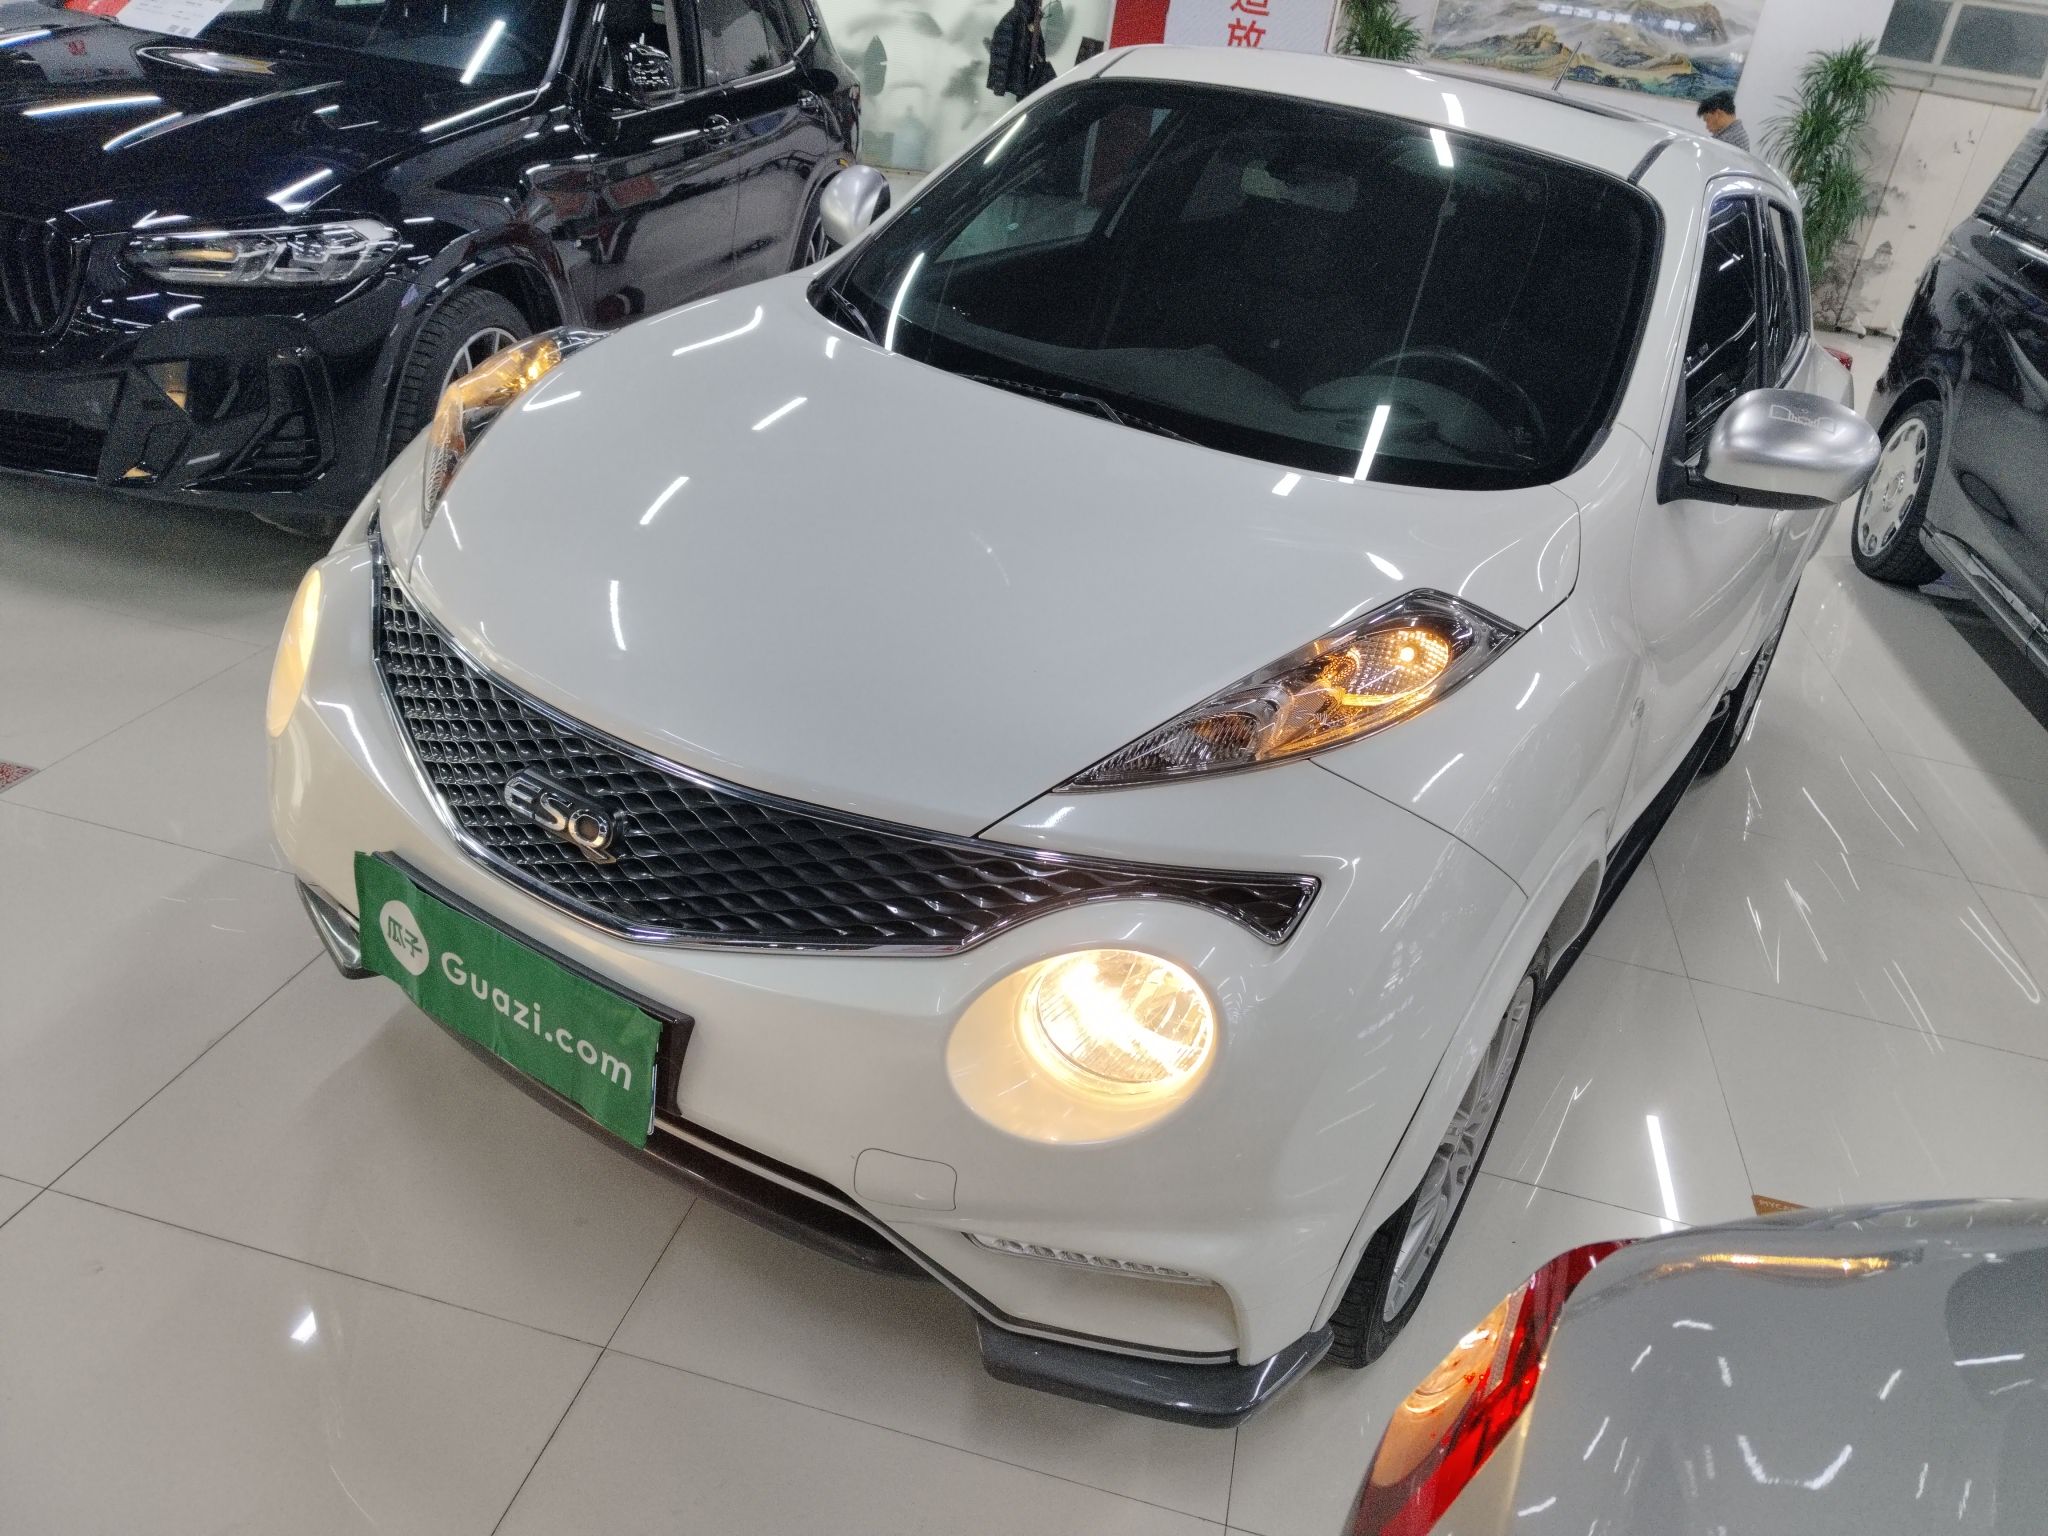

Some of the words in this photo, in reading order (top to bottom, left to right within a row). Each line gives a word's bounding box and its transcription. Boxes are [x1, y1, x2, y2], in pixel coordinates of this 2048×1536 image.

[504, 774, 617, 865] ESQ
[388, 915, 423, 960] 瓜子
[440, 952, 633, 1091] Guazi.com
